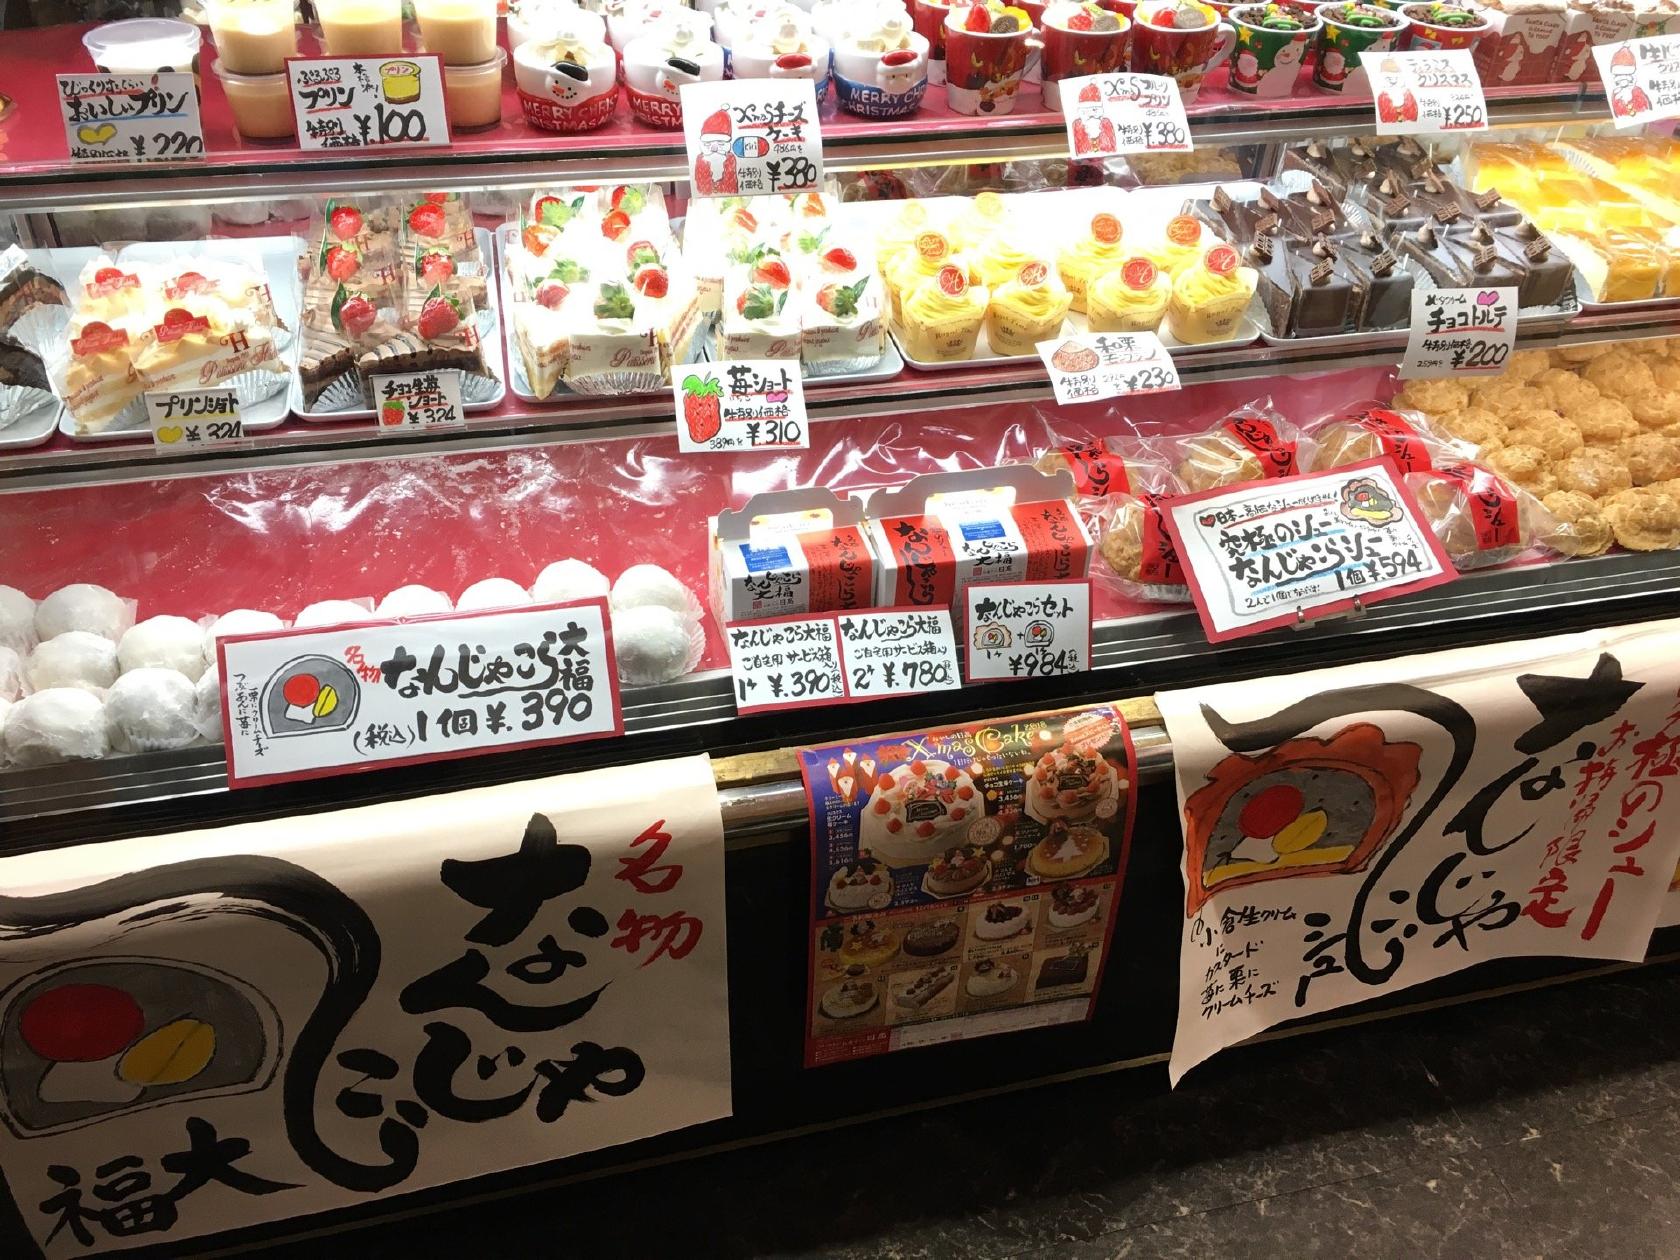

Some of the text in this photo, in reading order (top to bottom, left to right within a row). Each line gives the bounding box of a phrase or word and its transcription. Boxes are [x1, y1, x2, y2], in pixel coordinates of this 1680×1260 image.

[66, 88, 190, 122] おいしいプリン
[299, 86, 356, 110] プリン
[523, 99, 573, 118] MERRY
[632, 98, 682, 116] MERRY
[850, 87, 899, 104] MERRY
[765, 124, 802, 141] ケーキ
[1427, 304, 1508, 334] チョコトルテ
[1450, 340, 1509, 368] ¥200
[727, 364, 793, 396] 苺ショート
[724, 404, 791, 420] 特別価格
[1218, 513, 1333, 559] 究極のシュー
[1229, 532, 1383, 588] なんじゃこらシュー
[975, 594, 1074, 623] なんじゃこらセット
[731, 622, 832, 650] なんじゃこら大福
[839, 613, 943, 643] なんじゃこら大福
[344, 644, 382, 684] 名物
[1008, 648, 1069, 677] ¥984
[352, 721, 416, 756] (税込)
[975, 723, 1034, 754] Cake
[609, 819, 704, 969] 名物
[1205, 940, 1264, 982] カスタード
[1201, 980, 1280, 1020] クリームチーズ
